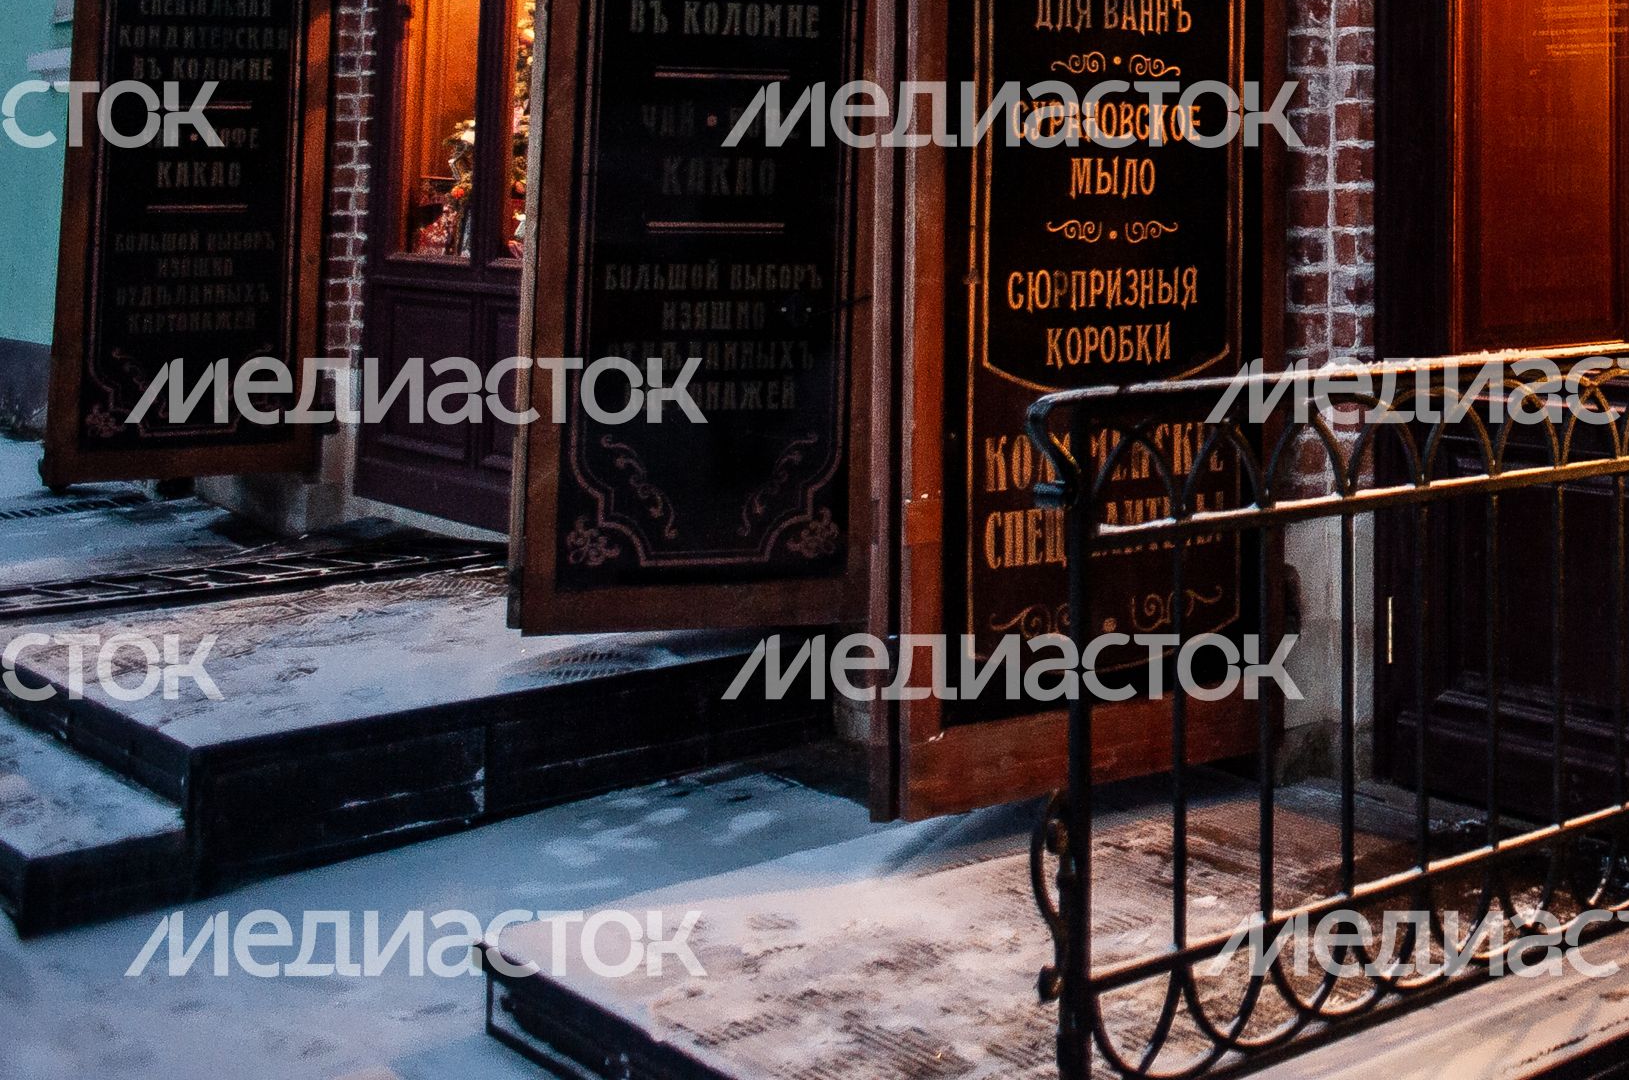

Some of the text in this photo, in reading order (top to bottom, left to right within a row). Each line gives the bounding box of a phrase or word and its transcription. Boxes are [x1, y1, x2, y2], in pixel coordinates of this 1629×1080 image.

[119, 24, 288, 50] КОНДИТЕРСКАЯ
[629, 0, 820, 39] ВЪ КОЛОМНЕ
[132, 56, 163, 80] ВЪ
[1011, 100, 1202, 146] СУРАНОВСКОЕ
[156, 161, 241, 189] КАКАО
[661, 156, 777, 197] КАКАО
[1069, 156, 1156, 200] МЫЛО
[604, 258, 823, 291] БОЛЬШОЙ ВЫБОРЪ
[1007, 264, 1199, 314] СЮРПРИЗНЫЯ
[1045, 321, 1172, 370] КОРОБКИ
